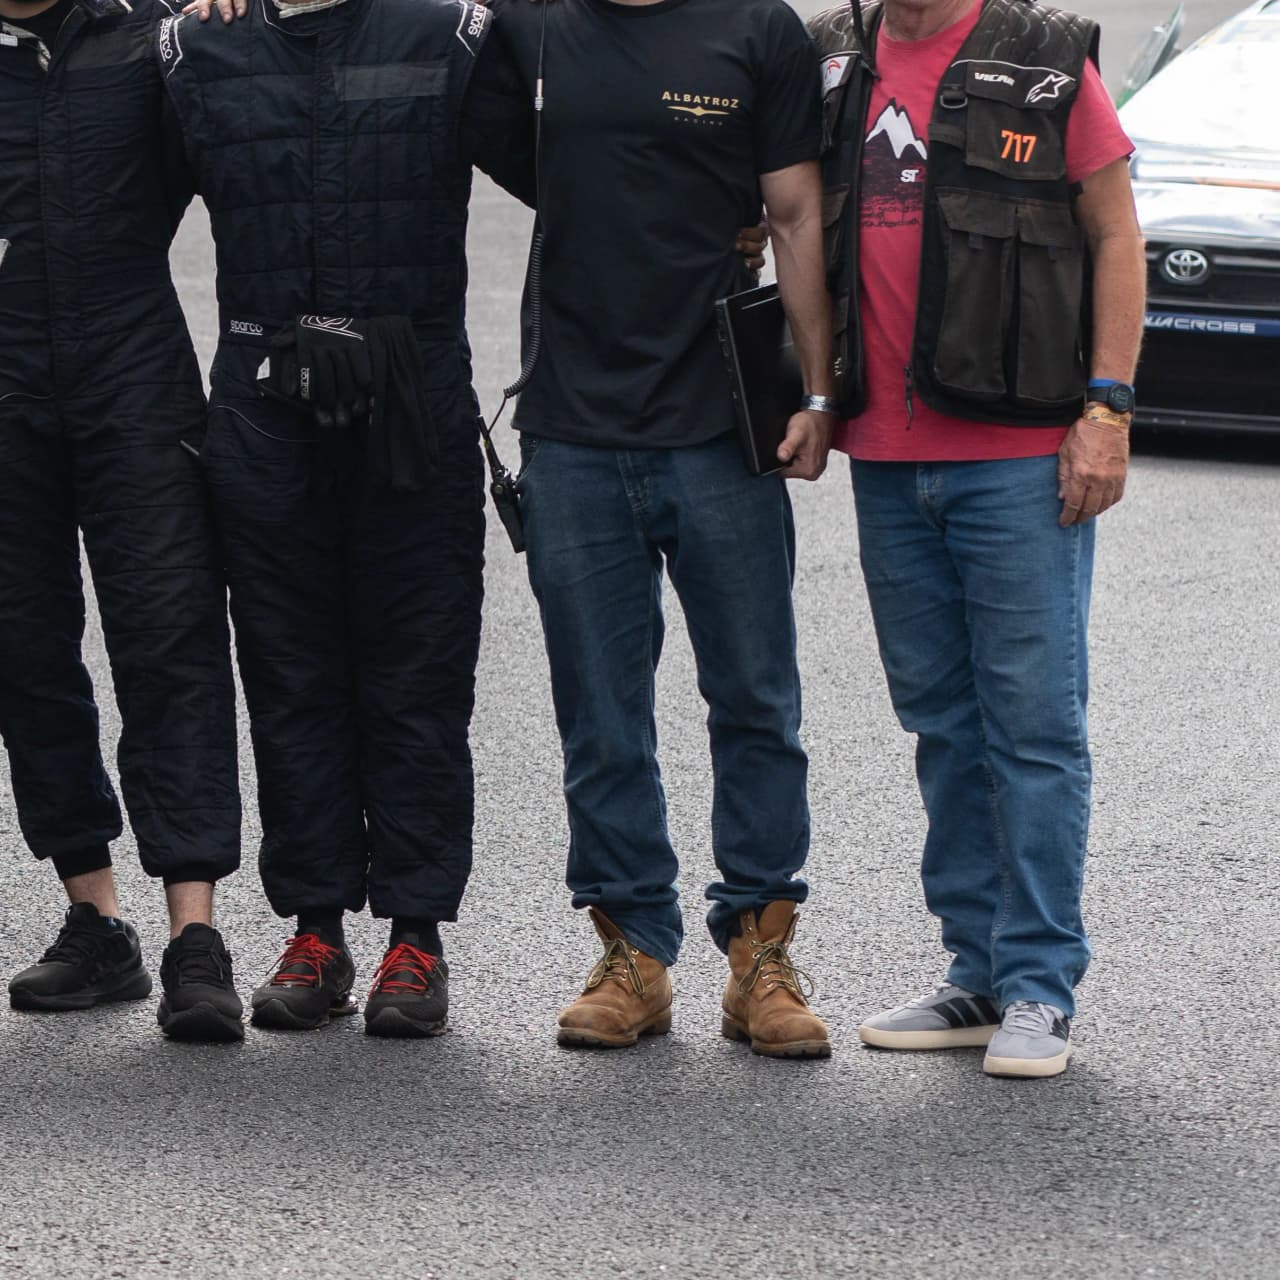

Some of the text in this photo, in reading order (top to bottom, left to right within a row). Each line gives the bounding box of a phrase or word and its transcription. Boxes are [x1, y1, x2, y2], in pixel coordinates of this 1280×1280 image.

[662, 90, 739, 109] ALBATROZ
[1000, 129, 1037, 163] 717
[230, 320, 264, 335] sparco
